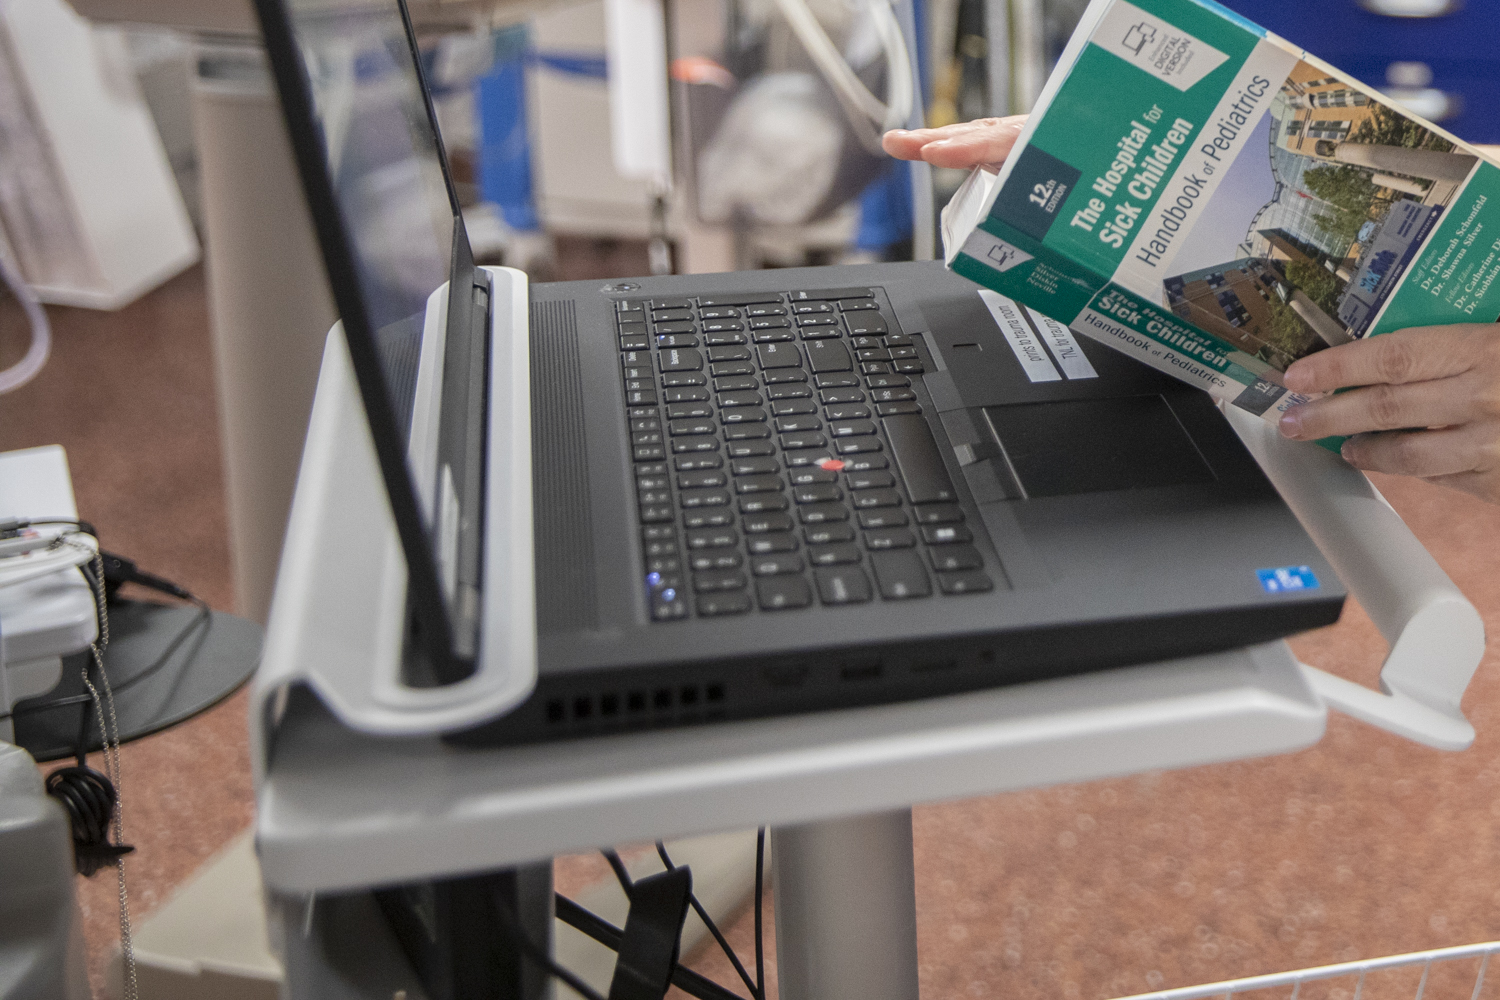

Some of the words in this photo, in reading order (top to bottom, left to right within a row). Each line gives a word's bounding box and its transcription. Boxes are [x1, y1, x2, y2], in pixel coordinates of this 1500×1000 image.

[1154, 36, 1181, 70] DIGITAL
[1162, 38, 1192, 76] VERSION
[1201, 76, 1270, 161] Pediatrics
[1070, 197, 1106, 232] The
[1092, 120, 1152, 198] Hospital
[1143, 104, 1164, 124] for
[1099, 200, 1142, 249] Sick
[1128, 117, 1194, 200] Children
[1203, 161, 1216, 176] of
[1028, 178, 1057, 208] 12th
[1046, 184, 1068, 214] EDITION
[1136, 173, 1208, 267] Handbook
[1420, 276, 1435, 290] Dr.
[1430, 236, 1460, 275] Deborah
[1456, 194, 1488, 237] Schonfeld
[1430, 282, 1446, 296] Dr.
[1442, 248, 1467, 280] Shawna
[1463, 222, 1484, 247] Silver
[1031, 272, 1058, 289] Diskin
[1035, 266, 1058, 282] Silver
[1412, 266, 1426, 284] Staff
[1421, 248, 1438, 270] Editors
[1454, 294, 1468, 310] Dr.
[1464, 251, 1496, 293] Catherine
[1026, 277, 1056, 295] Neville
[999, 304, 1013, 321] room
[1108, 289, 1138, 310] The
[1142, 303, 1212, 346] Hospital
[1464, 300, 1479, 315] Dr.
[1008, 319, 1028, 340] trauma
[1044, 318, 1066, 340] trauma
[1098, 297, 1143, 326] Sick
[1146, 319, 1228, 368] Children
[1024, 345, 1044, 362] prints
[1084, 313, 1152, 351] Handbook
[1163, 352, 1227, 388] Pediatrics
